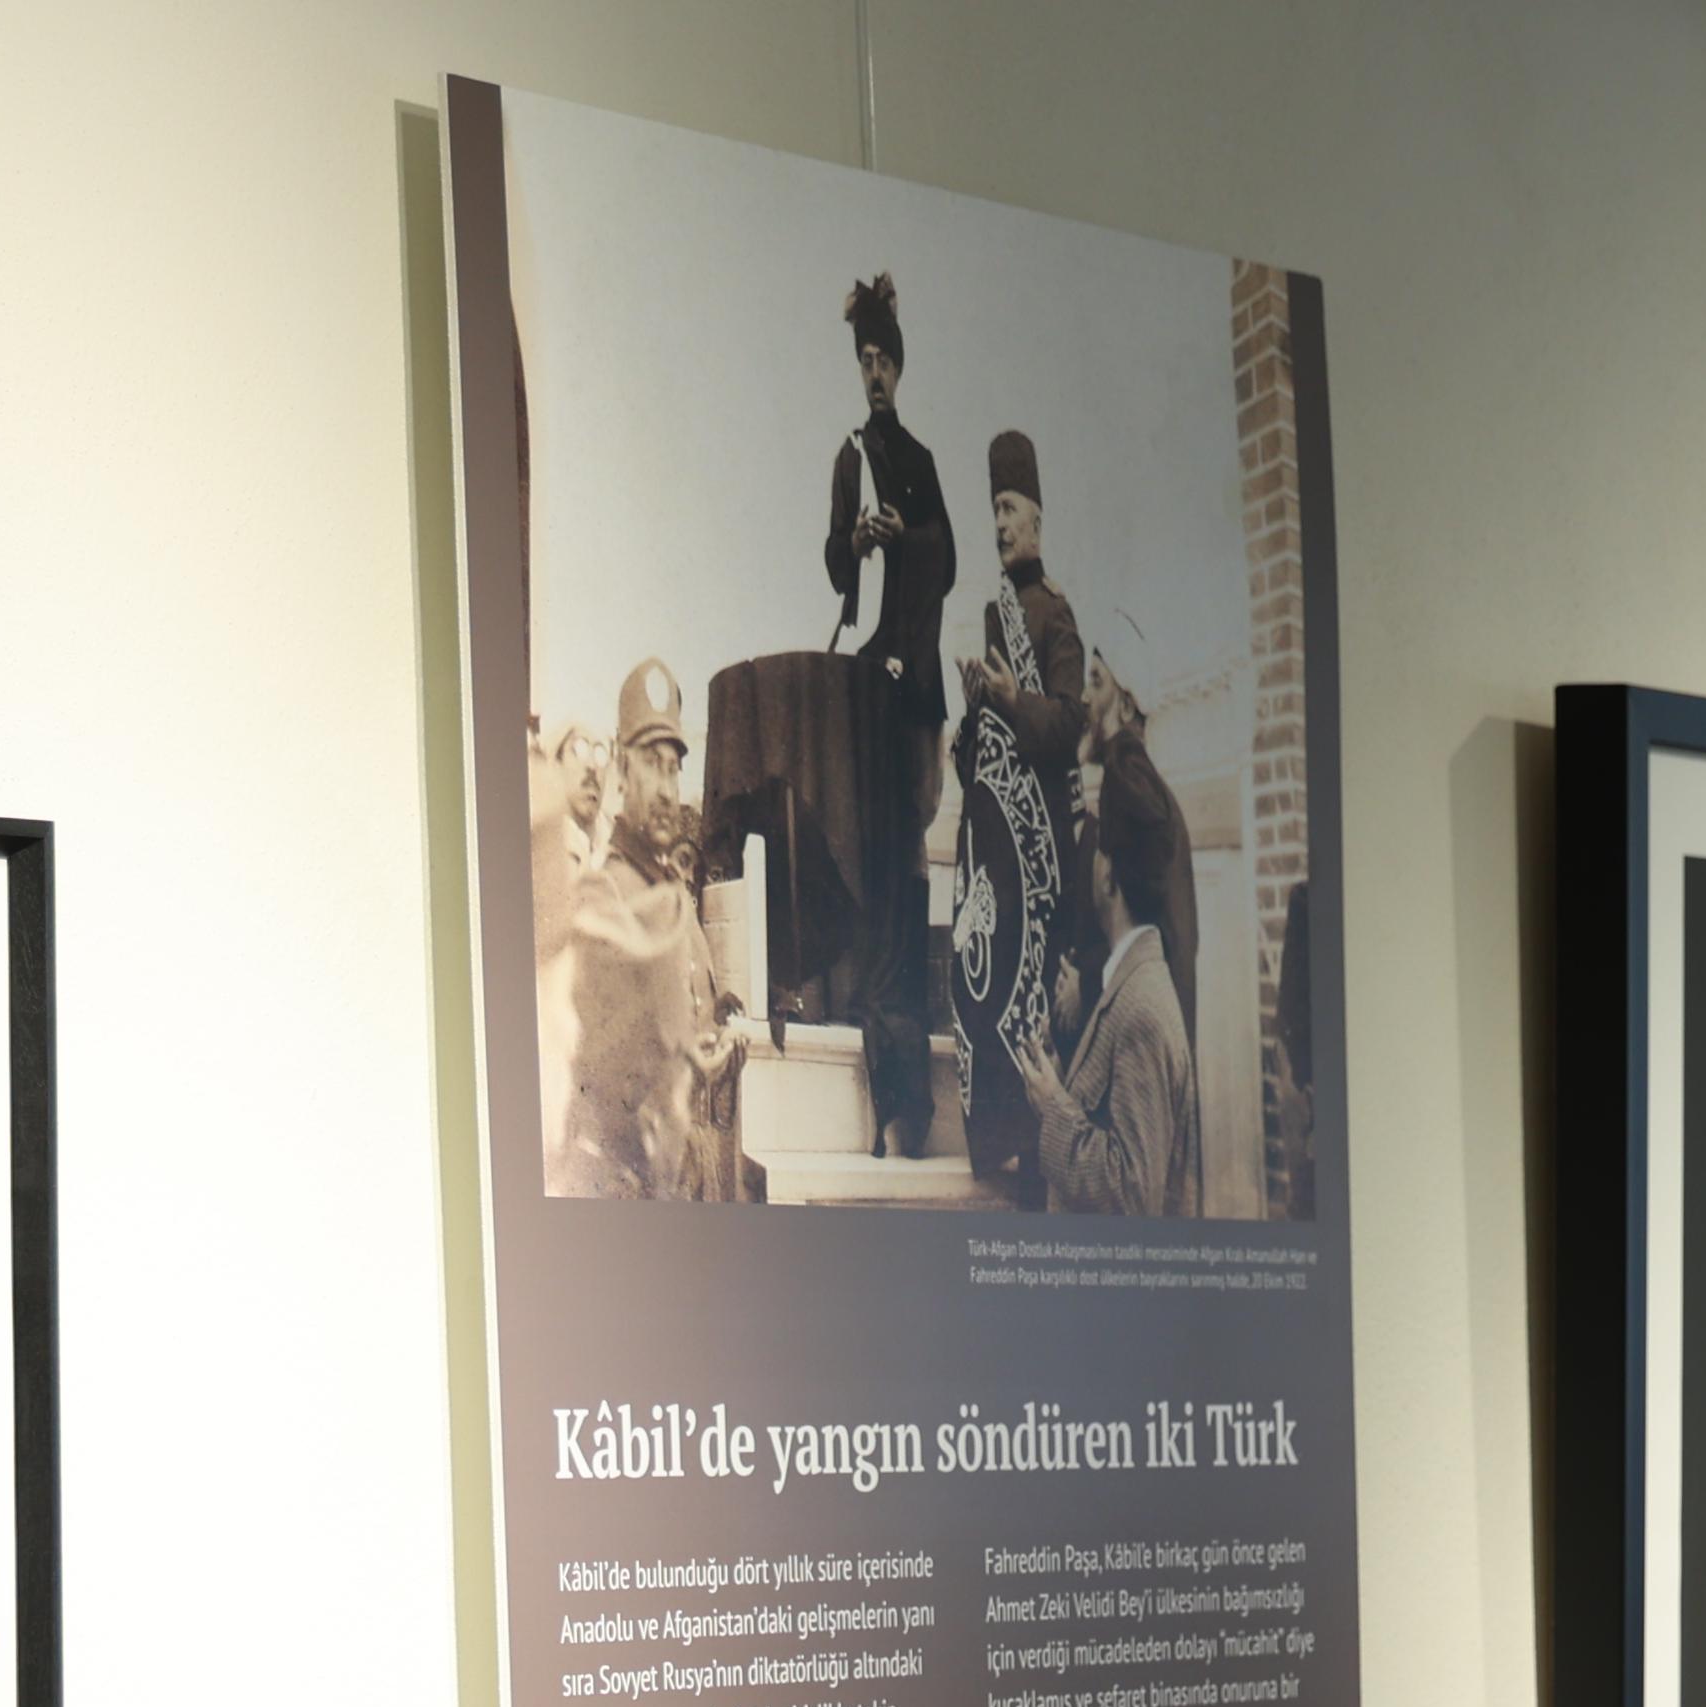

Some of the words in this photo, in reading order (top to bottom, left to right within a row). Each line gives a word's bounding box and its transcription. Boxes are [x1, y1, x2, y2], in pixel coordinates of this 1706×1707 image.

[553, 1400, 756, 1480] Kâbil’de
[766, 1423, 925, 1495] yangın
[936, 1401, 1136, 1473] söndüren
[1145, 1401, 1197, 1468] iki
[1206, 1400, 1299, 1467] Türk
[635, 1557, 728, 1594] bulunduğu
[733, 1556, 769, 1585] dört
[773, 1554, 814, 1591] yıllık
[817, 1553, 852, 1582] süre
[857, 1550, 933, 1587] içerisinde
[984, 1545, 1061, 1575] Fahreddin
[1064, 1543, 1103, 1578] Paşa,
[1155, 1540, 1199, 1573] birkaç
[1201, 1539, 1229, 1573] gün
[1231, 1538, 1264, 1565] önce
[1267, 1537, 1306, 1570] gelen
[560, 1612, 633, 1644] Anadolu
[637, 1617, 658, 1640] ve
[797, 1600, 898, 1640] gelişmelerin
[901, 1605, 934, 1634] yanı
[985, 1595, 1036, 1623] Ahmet
[1038, 1591, 1070, 1620] Zeki
[1072, 1590, 1114, 1619] Velidi
[1156, 1586, 1220, 1614] ülkesinin
[1222, 1581, 1304, 1617] bağımsızlığı
[562, 1673, 594, 1696] sıra
[599, 1664, 658, 1700] Sovyet
[747, 1652, 849, 1688] diktatörlüğü
[853, 1648, 922, 1679] altındaki
[986, 1643, 1015, 1678] için
[1017, 1639, 1070, 1674] verdiği
[1073, 1635, 1171, 1666] mücadeleden
[1174, 1633, 1217, 1664] dolayı
[1285, 1627, 1315, 1659] diye
